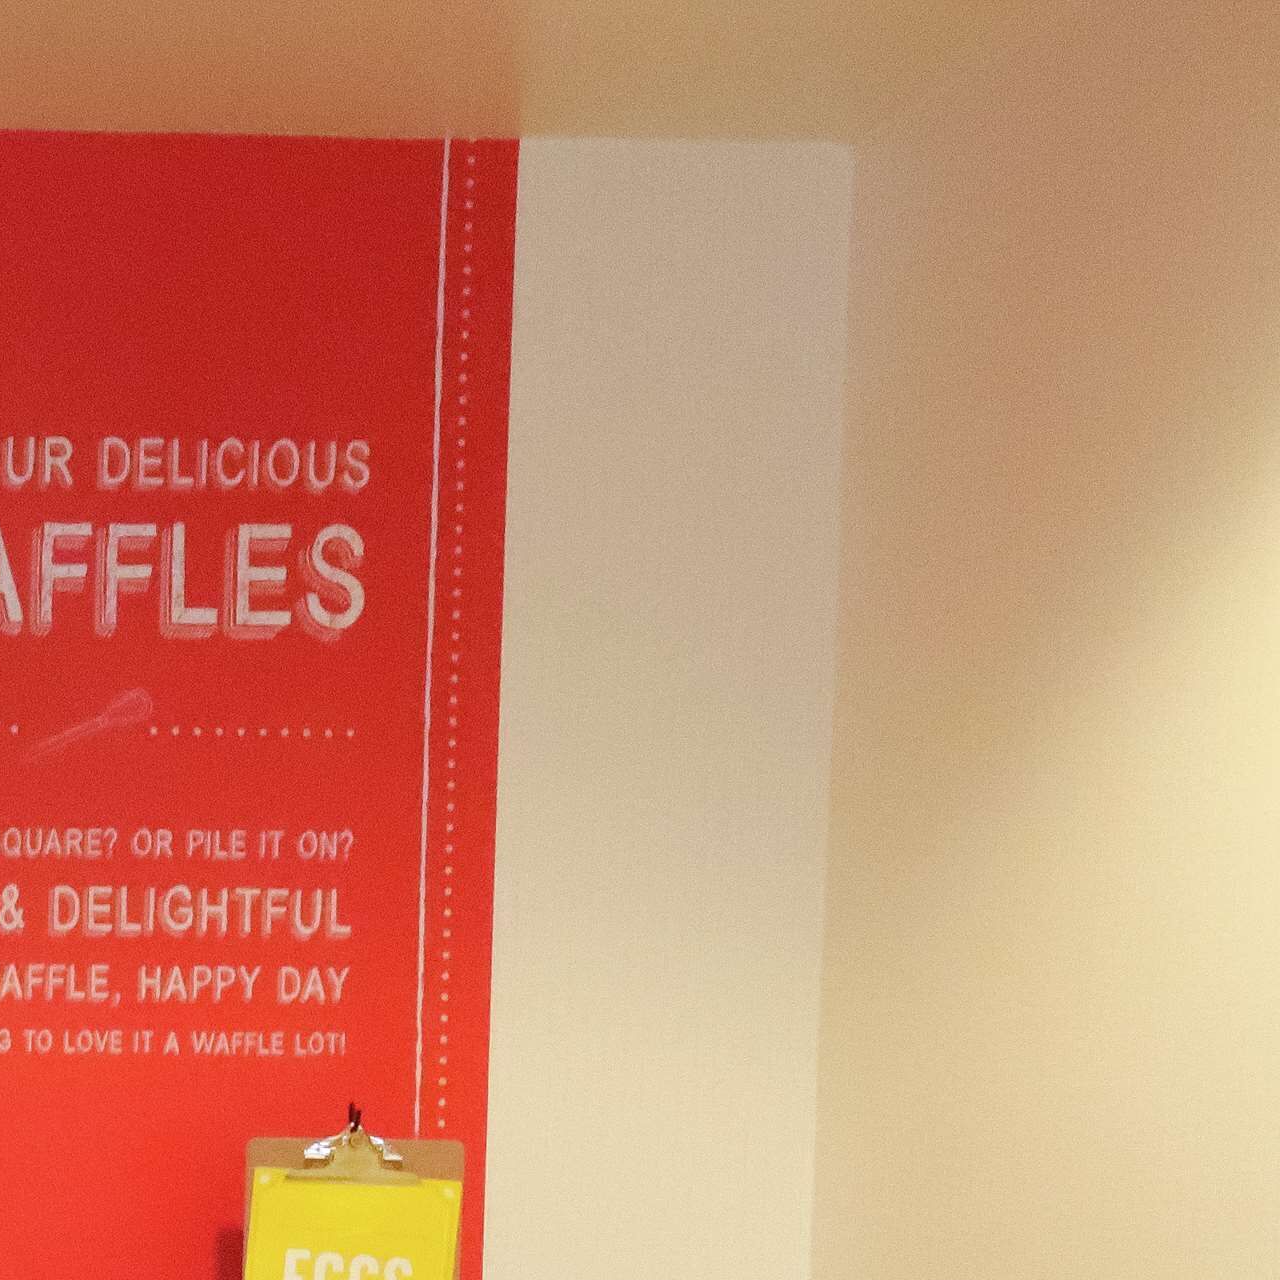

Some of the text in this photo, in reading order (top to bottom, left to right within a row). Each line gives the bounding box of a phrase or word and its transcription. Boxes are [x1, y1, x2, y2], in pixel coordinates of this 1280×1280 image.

[96, 435, 372, 493] DELICIOUS
[131, 827, 174, 858] OR
[186, 828, 247, 860] PILE
[258, 829, 285, 859] IT
[296, 828, 355, 861] ON?
[47, 883, 352, 938] DELIGHTFUL
[136, 963, 261, 1003] HAPPY
[275, 964, 350, 1004] DAY
[23, 1028, 53, 1053] TO
[63, 1029, 123, 1054] LOVE
[132, 1030, 154, 1054] IT
[163, 1031, 180, 1055] A
[191, 1031, 285, 1056] WAFFLE
[294, 1031, 346, 1056] LOT!
